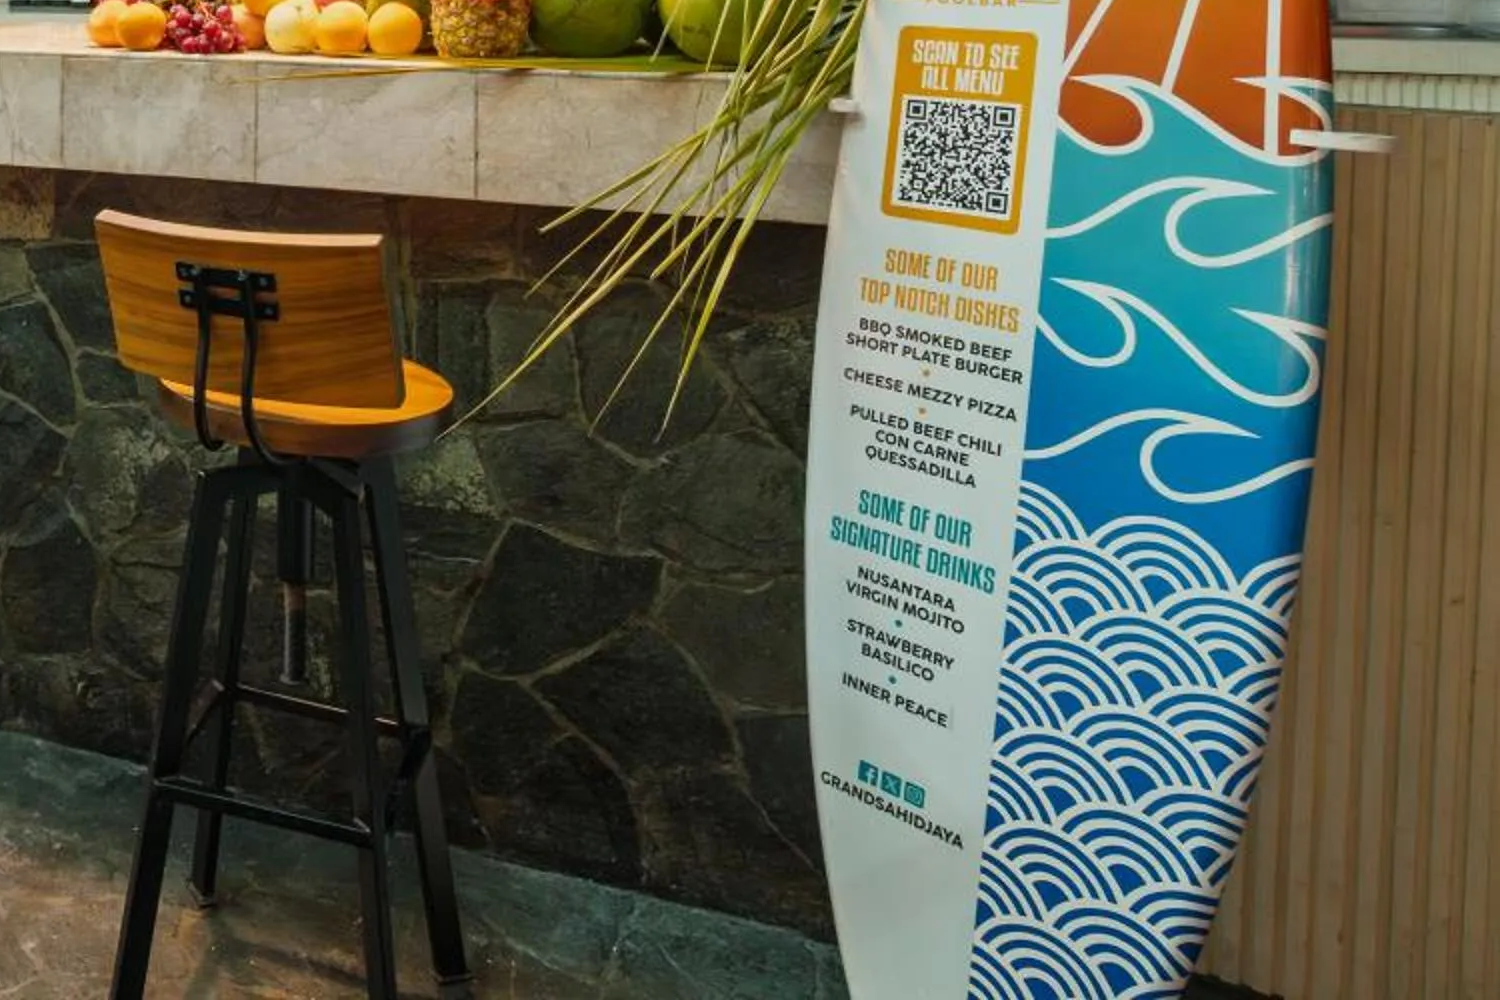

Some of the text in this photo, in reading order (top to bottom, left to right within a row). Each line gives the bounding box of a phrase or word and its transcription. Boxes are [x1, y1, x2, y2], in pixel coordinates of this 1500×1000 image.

[912, 39, 1020, 70] SCAN TO SEE
[921, 66, 1005, 95] ALL MENU
[885, 248, 998, 292] SOME OF OUR
[860, 277, 1020, 333] TOP NOTCH DISHES
[846, 333, 1023, 384] SHORT PLATE BURGER
[859, 317, 1013, 363] BBQ SMOKED BEEF
[844, 367, 1017, 422] CHEESE MEZZY PIZZA
[850, 404, 1002, 457] PULLED BEEF CHILI
[875, 430, 970, 467] CON CARNE
[865, 445, 977, 488] QUESSADILLA
[858, 489, 972, 548] SOME OF OUR
[830, 516, 996, 594] SIGNATURE DRINKS
[846, 580, 965, 634] VIRGIN MOJITO
[857, 565, 956, 613] NUSANTARA
[847, 618, 955, 670] STRAWBERRY
[861, 643, 935, 682] BASILICO
[842, 672, 948, 728] INNER PEACE
[820, 770, 964, 850] GRANDSAHIDJAYA
